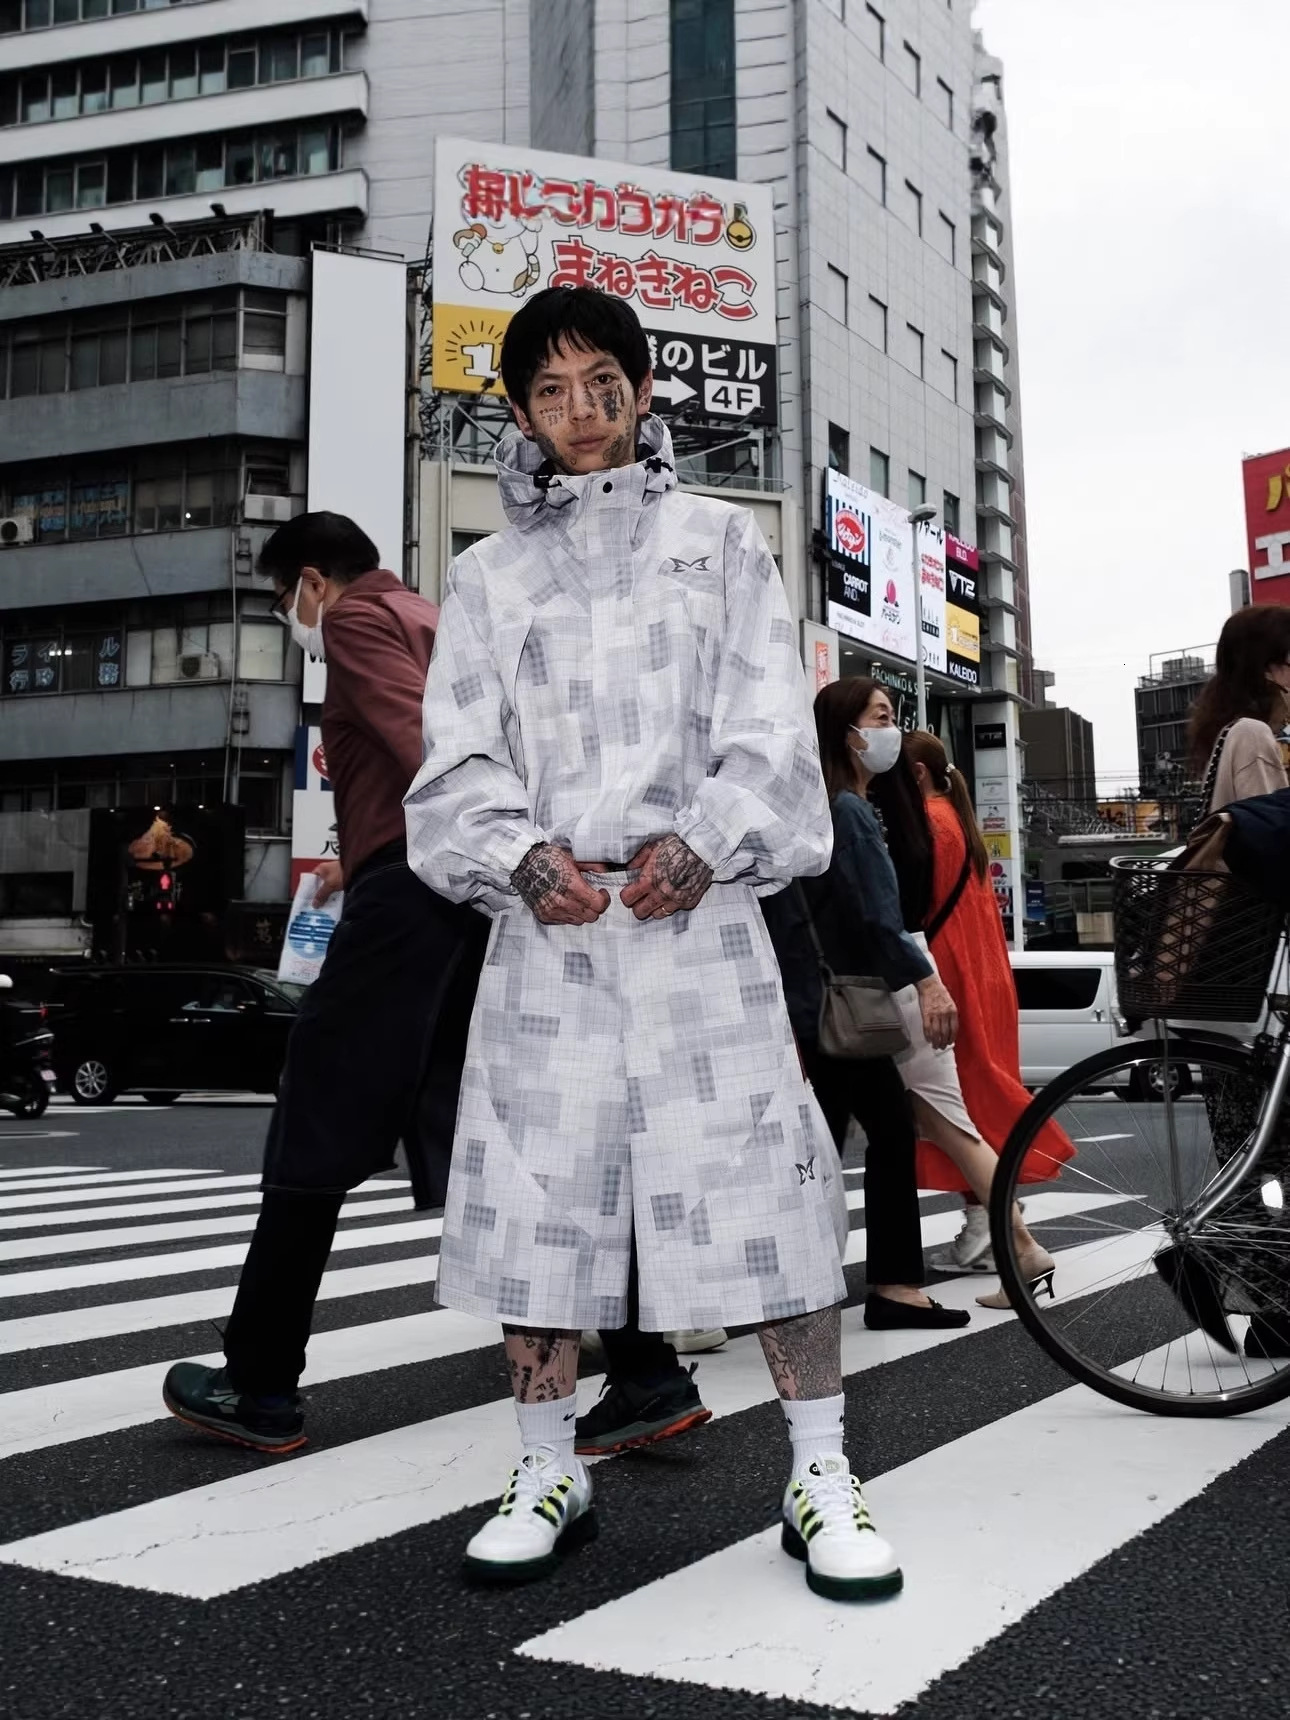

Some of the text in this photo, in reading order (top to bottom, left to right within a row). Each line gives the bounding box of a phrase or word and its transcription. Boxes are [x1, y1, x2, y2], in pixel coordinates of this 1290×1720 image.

[549, 236, 758, 321] まねきねこ
[711, 386, 755, 410] 4F
[843, 572, 868, 594] CARROT
[872, 666, 907, 691] PACHINKO
[949, 661, 977, 684] KALEIDO
